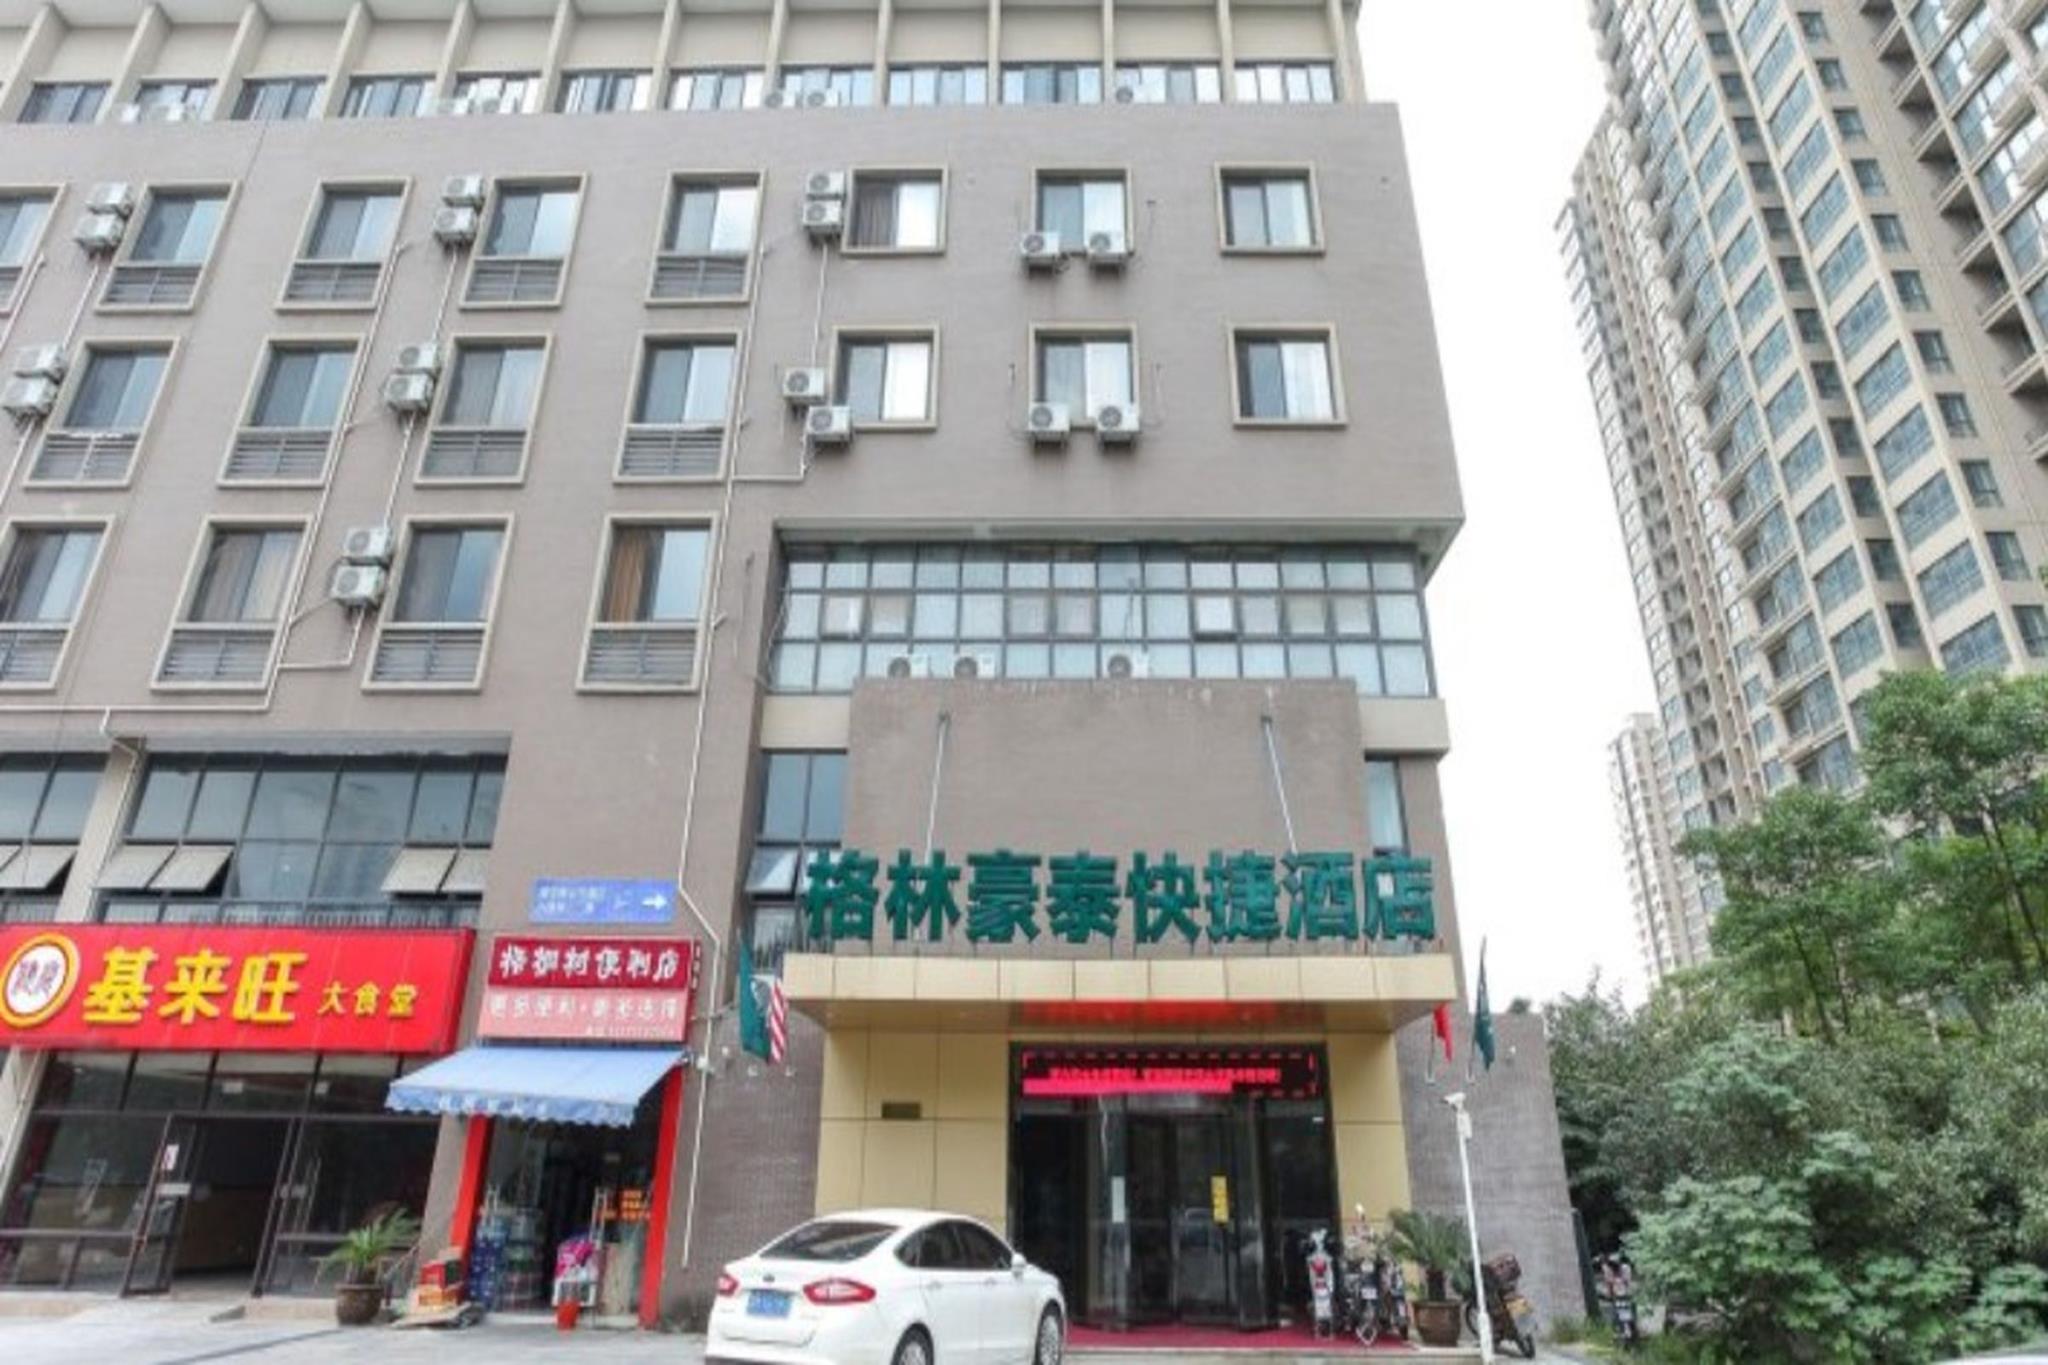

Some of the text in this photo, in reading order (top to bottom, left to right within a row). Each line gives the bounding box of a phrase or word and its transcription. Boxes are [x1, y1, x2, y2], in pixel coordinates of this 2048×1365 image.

[803, 850, 1436, 943] 格林豪泰快捷酒店
[83, 946, 308, 1025] 基来旺
[317, 981, 419, 1018] 大食堂
